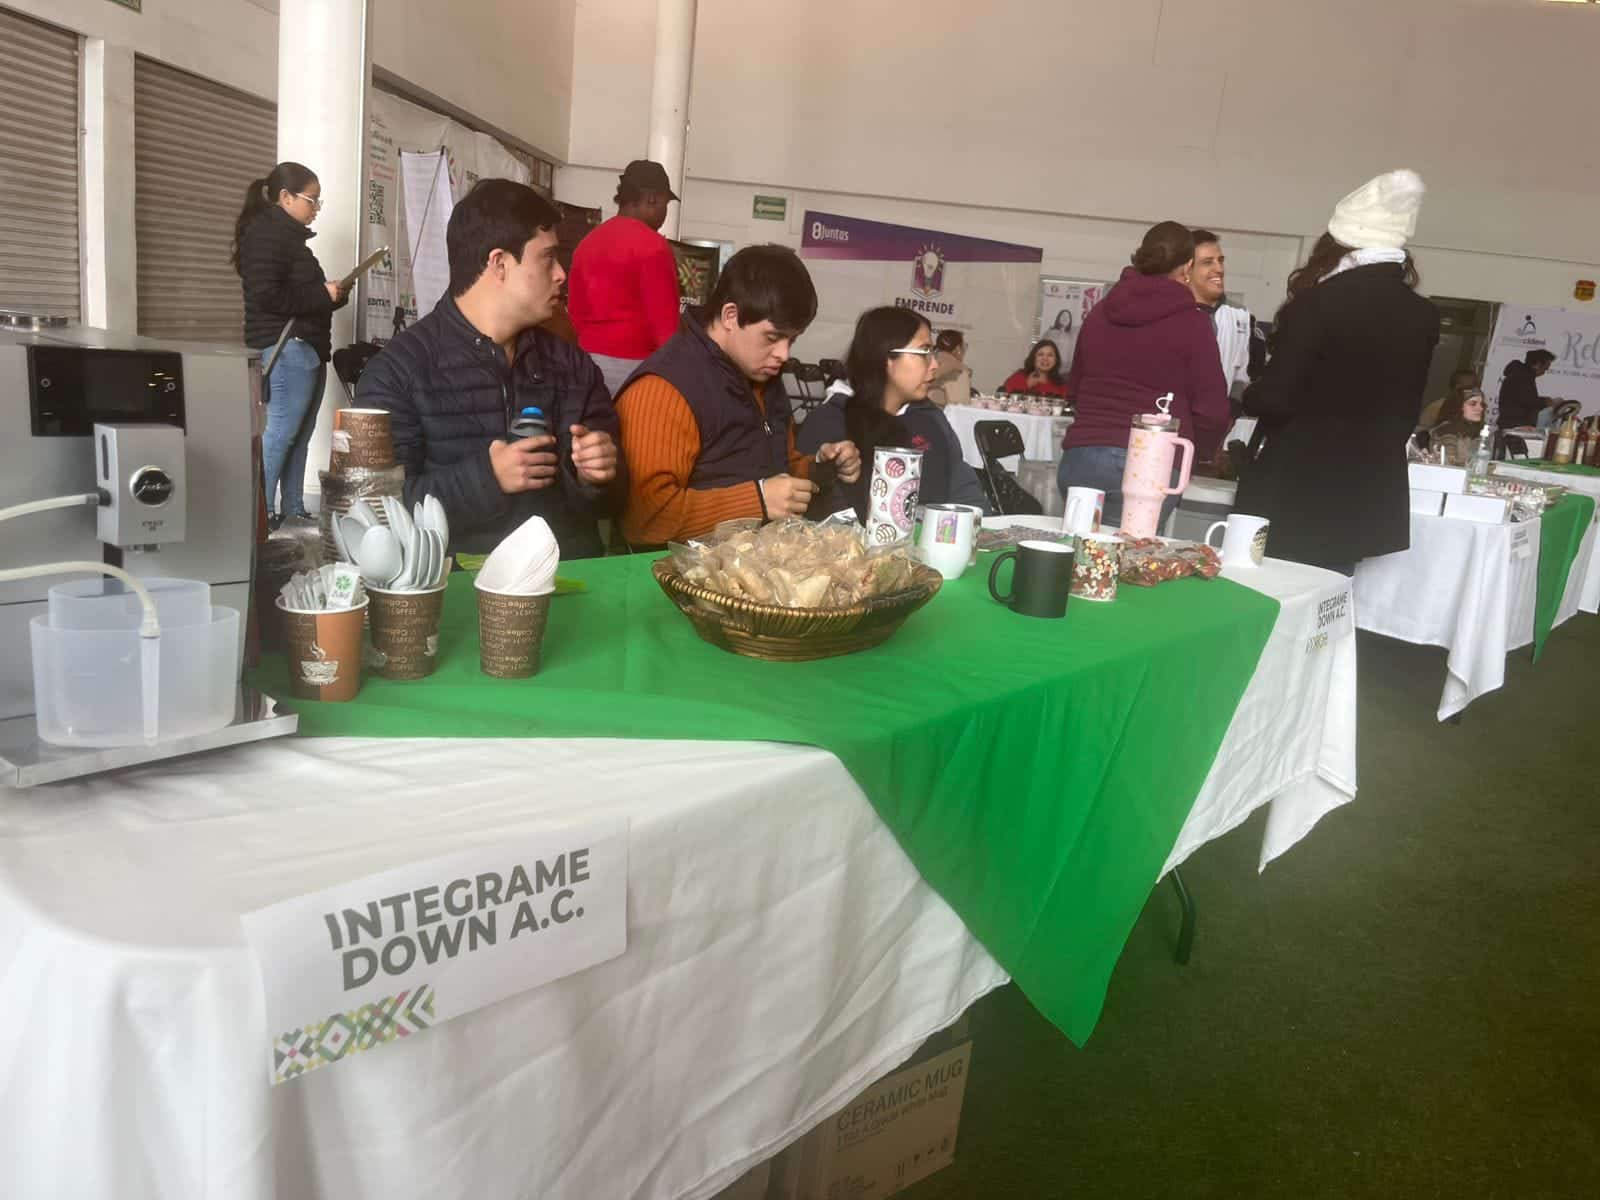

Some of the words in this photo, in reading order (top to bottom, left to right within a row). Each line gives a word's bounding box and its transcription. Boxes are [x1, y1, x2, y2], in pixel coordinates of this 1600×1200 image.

[895, 297, 954, 315] EMPRENDE
[324, 848, 590, 950] INTEGRAME
[342, 911, 497, 991] DOWN
[510, 889, 585, 939] A.C.
[837, 1079, 921, 1132] CERAMIC
[925, 1058, 964, 1089] MUG
